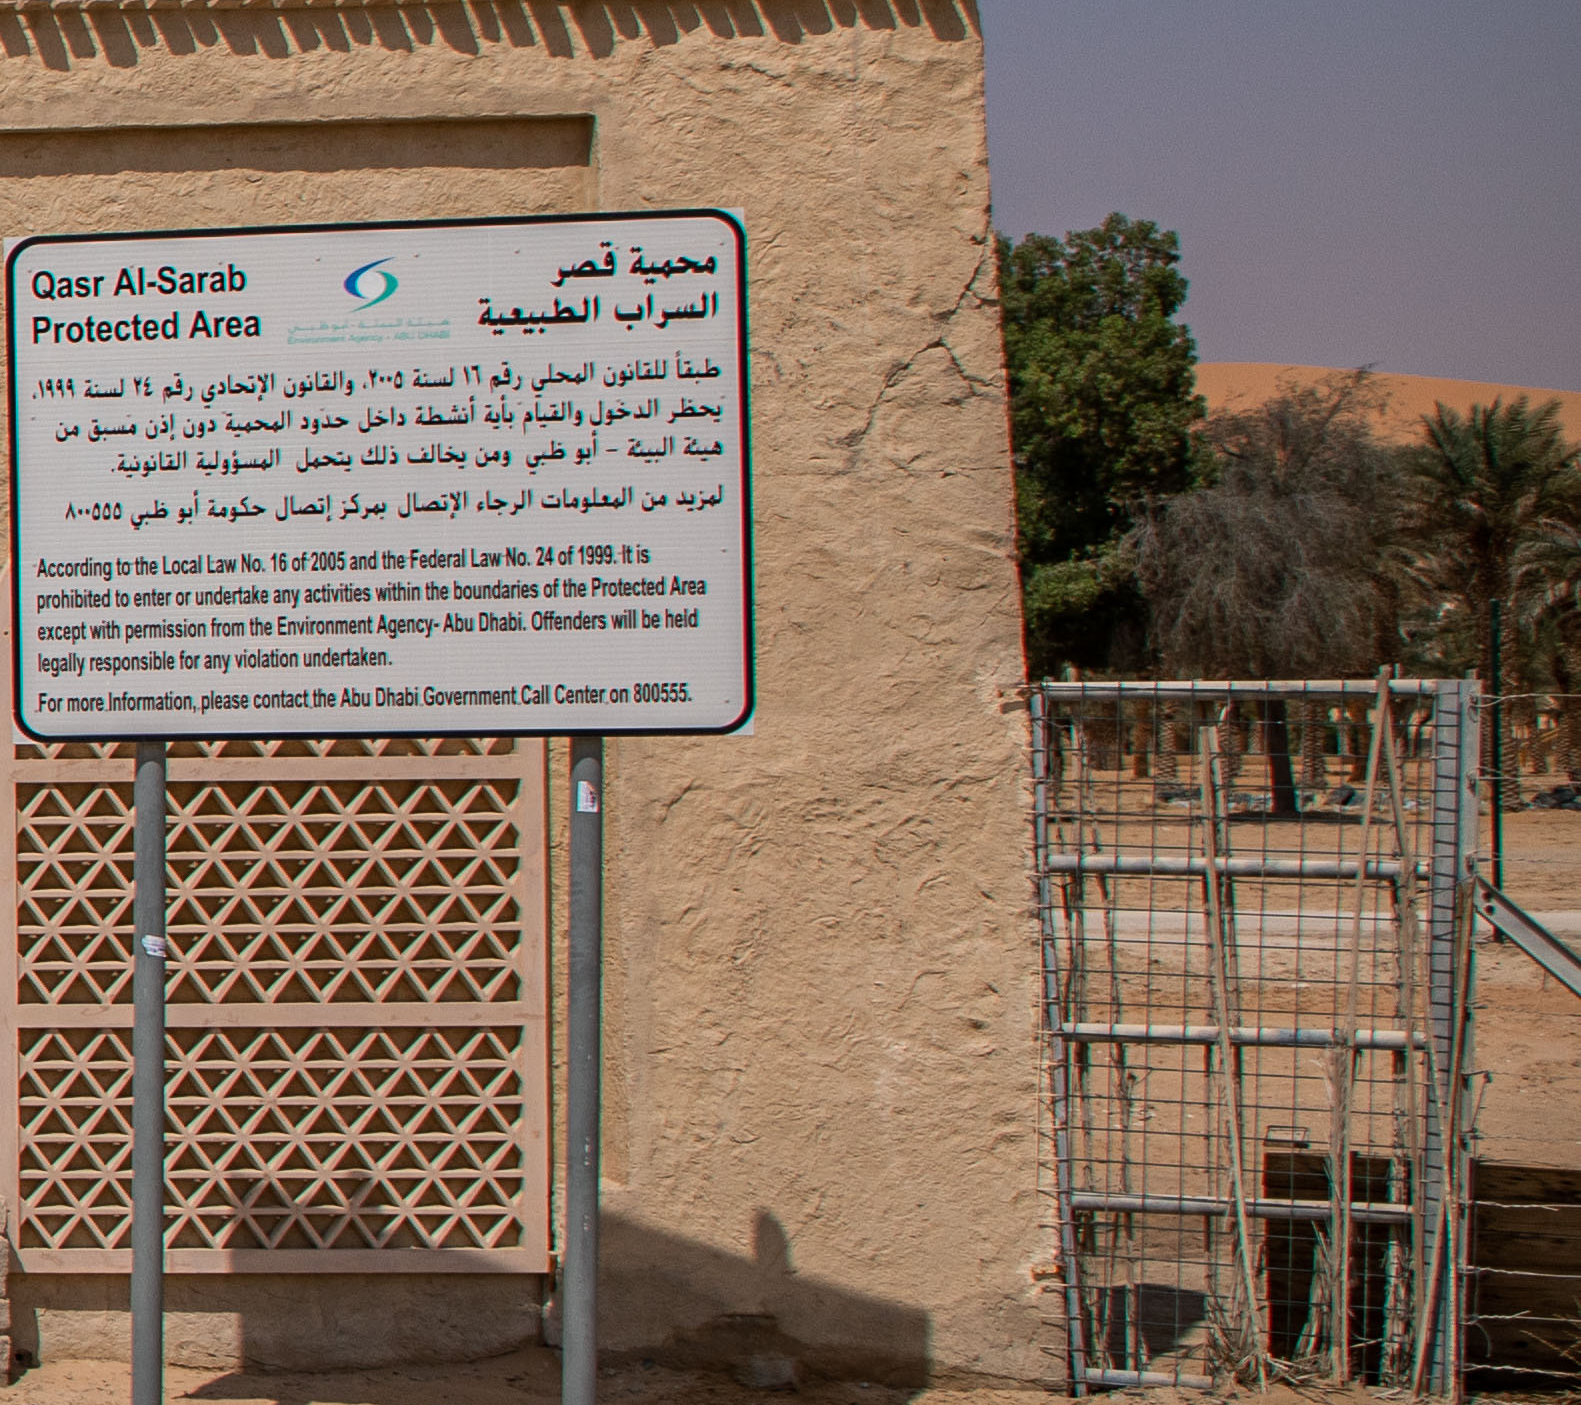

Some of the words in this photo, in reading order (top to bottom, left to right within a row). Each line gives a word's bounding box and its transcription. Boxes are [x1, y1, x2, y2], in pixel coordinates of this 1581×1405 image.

[550, 241, 617, 288] قصر
[629, 246, 717, 285] محمية
[31, 270, 105, 300] Qasr
[113, 263, 247, 297] Al-Sarab
[477, 295, 601, 336] الطبيعية
[613, 290, 719, 332] السراب
[32, 310, 179, 345] Protected
[188, 310, 261, 339] Area
[83, 378, 125, 399] لسنة
[133, 376, 153, 397] ٢٤
[162, 372, 193, 405] رقم
[283, 370, 355, 399] والقانون
[412, 367, 455, 388] لسنة
[463, 364, 481, 385] ١٦
[489, 361, 523, 394] رقم
[531, 361, 595, 398] المحلي
[603, 359, 668, 388] للقانون
[200, 372, 275, 409] الإتحادي
[224, 409, 291, 438] المحمية
[300, 415, 350, 436] حدود
[358, 406, 407, 434] داخل
[414, 395, 475, 426] أنشطة
[483, 394, 515, 430] بأية
[522, 400, 584, 435] والقيام
[589, 398, 659, 427] الدخول
[666, 397, 723, 425] يحظر
[55, 422, 80, 443] من
[87, 418, 137, 443] مسبق
[145, 413, 175, 441] إذن
[182, 418, 217, 439] دون
[36, 556, 113, 582] According
[115, 557, 133, 576] to
[134, 555, 159, 576] the
[162, 554, 202, 575] Local
[206, 554, 237, 574] Law
[241, 553, 266, 573] No.
[270, 552, 288, 573] 16
[291, 551, 310, 572] of
[310, 550, 346, 572] 2005
[349, 550, 378, 571] and
[381, 549, 407, 570] the
[409, 548, 466, 569] Federal
[470, 547, 504, 568] Law
[504, 546, 531, 567] No.
[535, 545, 555, 567] 24
[557, 544, 575, 566] of
[577, 544, 618, 566] 1999.
[621, 544, 633, 565] It
[635, 543, 651, 564] is
[36, 588, 111, 615] prohibited
[114, 589, 130, 608] to
[133, 588, 173, 608] enter
[175, 591, 192, 607] or
[195, 584, 269, 606] undertake
[273, 588, 301, 609] any
[303, 582, 372, 604] activities
[375, 581, 421, 602] within
[424, 580, 449, 601] the
[453, 579, 539, 601] boundaries
[543, 577, 560, 599] of
[562, 577, 587, 598] the
[591, 575, 667, 598] Protected
[669, 575, 707, 596] Area
[37, 621, 87, 646] except
[89, 619, 121, 640] with
[125, 618, 207, 644] permission
[210, 617, 245, 638] from
[249, 616, 273, 637] the
[277, 615, 373, 636] Environment
[442, 612, 475, 633] Abu
[478, 611, 527, 632] Dhabi.
[531, 610, 607, 632] Offenders
[610, 608, 637, 630] will
[641, 609, 661, 630] be
[664, 607, 699, 629] held
[37, 652, 85, 678] legally
[89, 650, 175, 677] responsible
[179, 649, 201, 670] for
[203, 654, 231, 675] any
[234, 648, 299, 669] violation
[303, 646, 393, 668] undertaken.
[38, 692, 64, 713] For
[67, 696, 105, 713] more
[108, 690, 197, 714] Information,
[200, 689, 249, 715] please
[253, 689, 310, 710] contact
[312, 687, 337, 708] the
[339, 687, 371, 708] Abu
[375, 686, 419, 707] Dhabi
[423, 685, 520, 707] Government
[520, 684, 551, 706] Call
[554, 683, 607, 705] Center
[609, 688, 629, 704] on
[633, 682, 693, 704] 800555.
